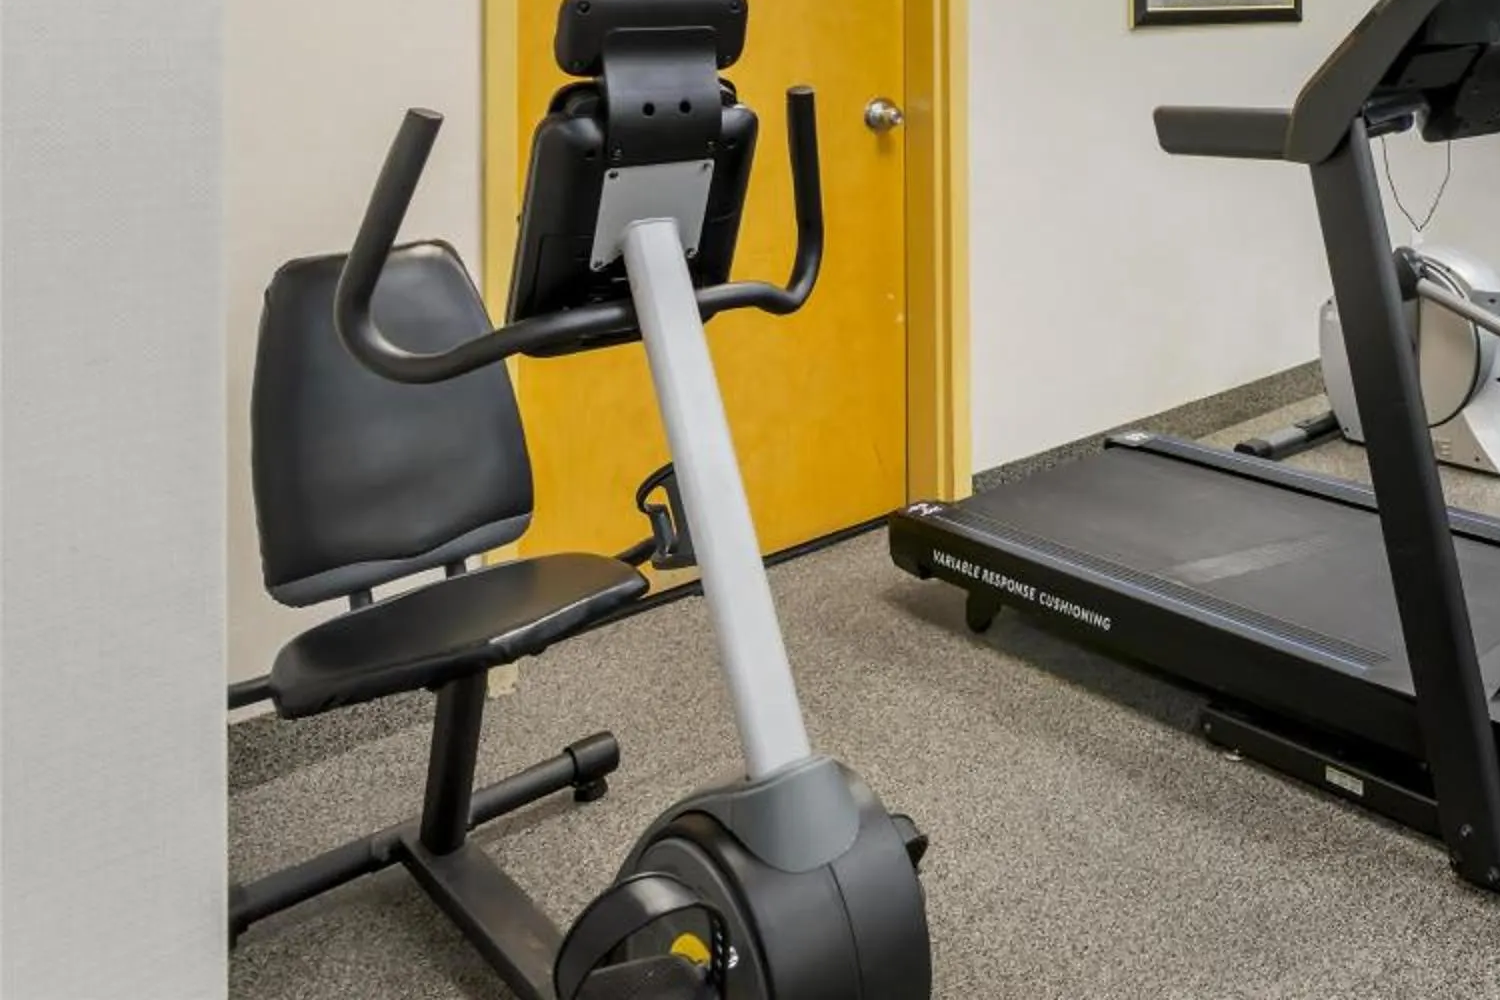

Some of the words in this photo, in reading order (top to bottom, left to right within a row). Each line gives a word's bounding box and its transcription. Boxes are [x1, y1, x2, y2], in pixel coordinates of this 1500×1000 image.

[933, 549, 980, 579] VARIABLE
[982, 568, 1036, 601] RESPONSE
[1039, 591, 1112, 631] CUSHIONING
